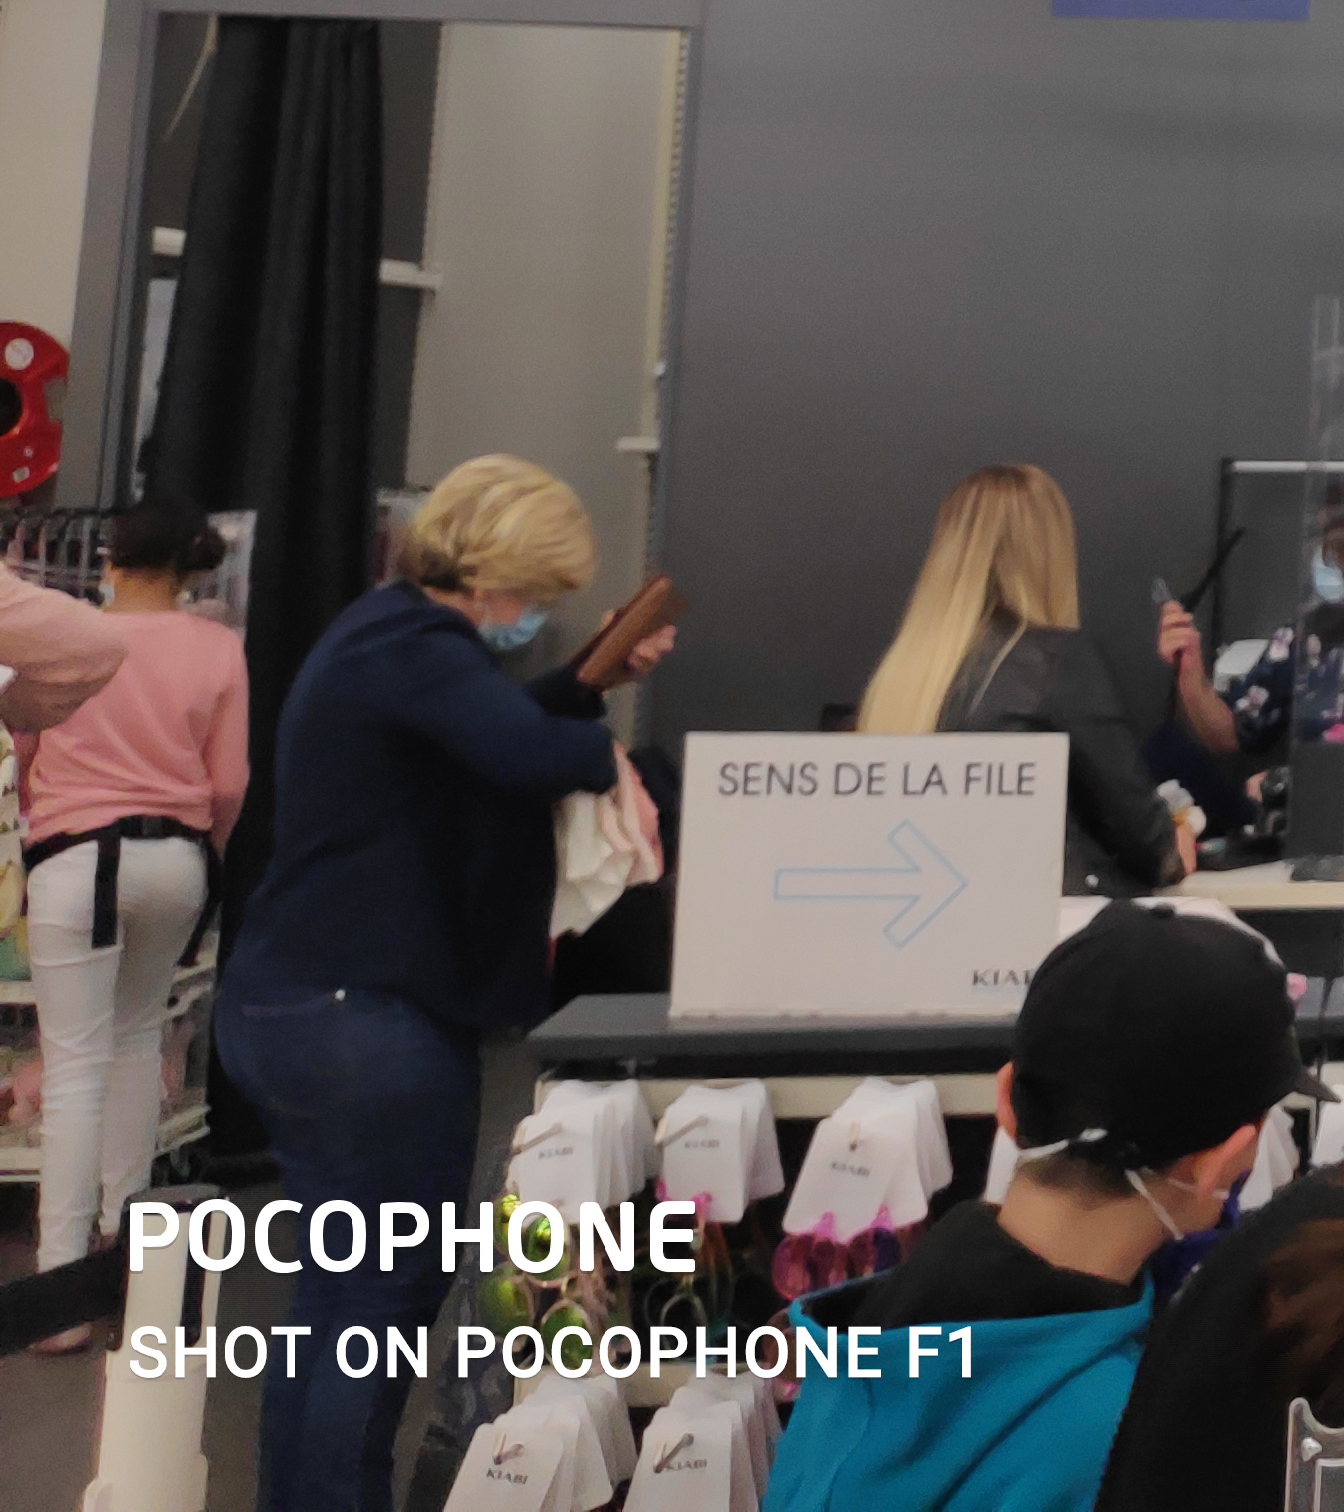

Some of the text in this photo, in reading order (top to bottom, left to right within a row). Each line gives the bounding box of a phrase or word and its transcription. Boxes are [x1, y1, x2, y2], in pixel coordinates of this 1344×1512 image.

[718, 762, 1036, 796] SENS DE LA FILE
